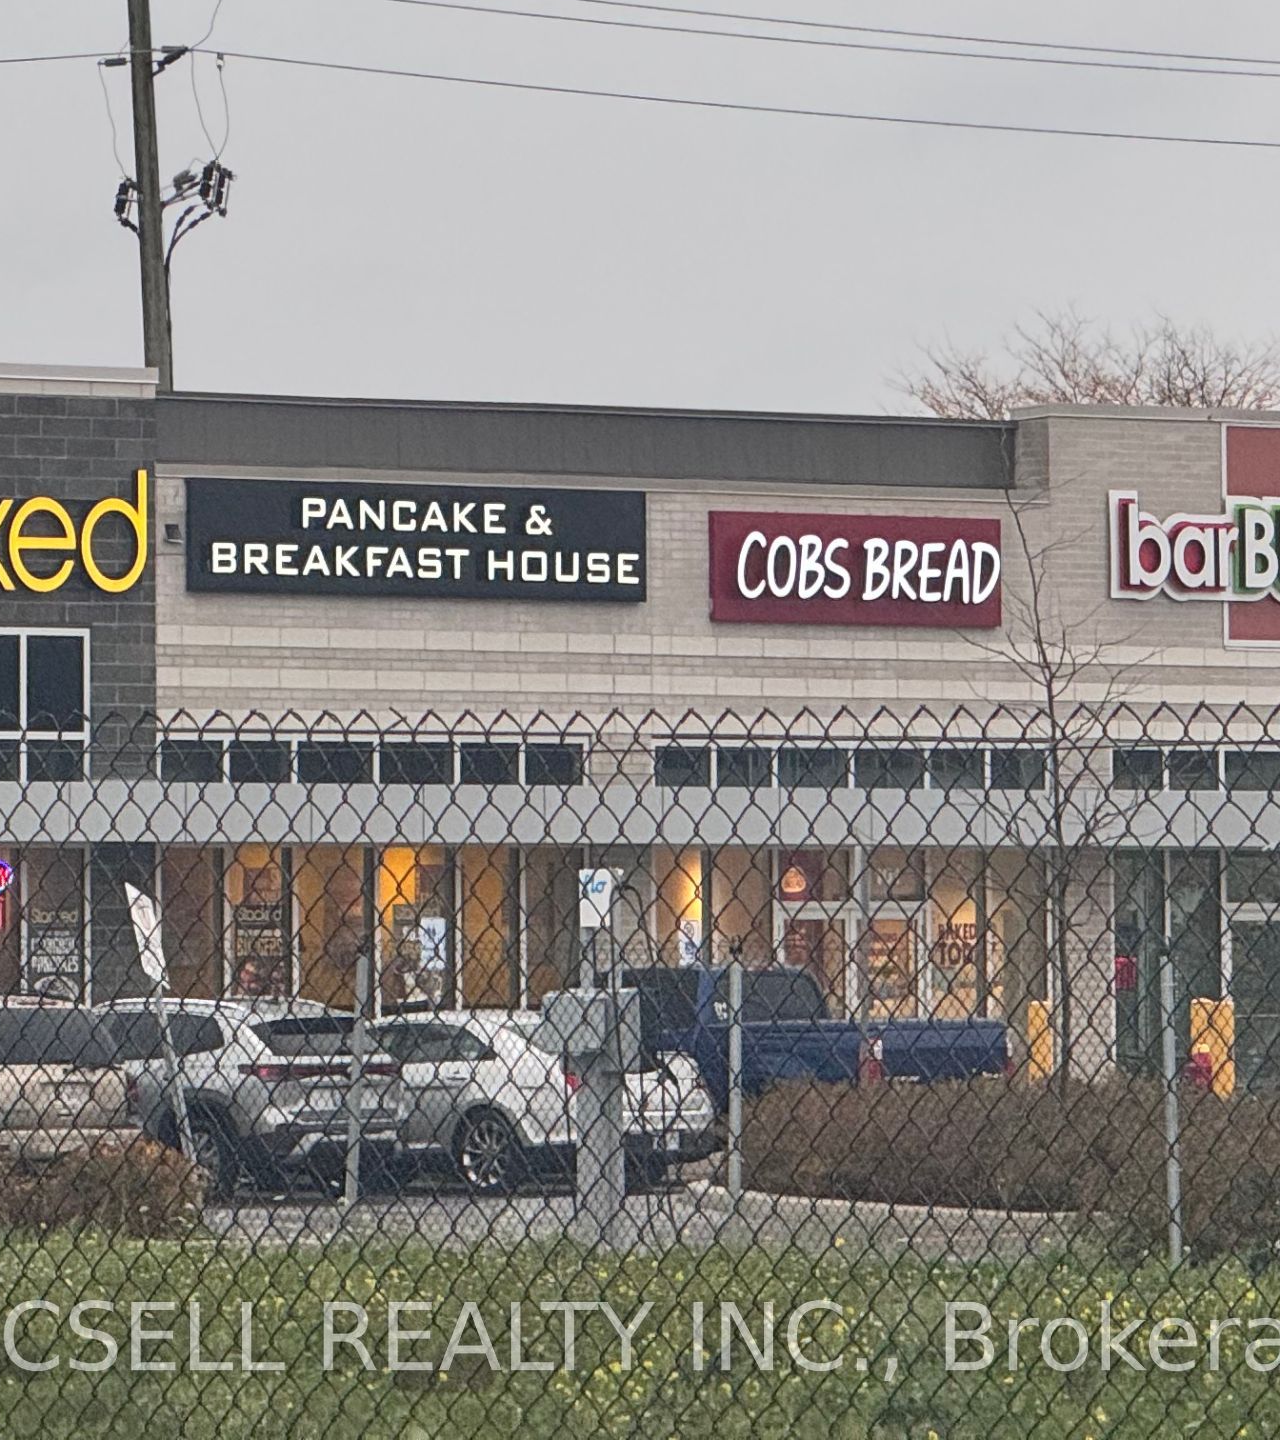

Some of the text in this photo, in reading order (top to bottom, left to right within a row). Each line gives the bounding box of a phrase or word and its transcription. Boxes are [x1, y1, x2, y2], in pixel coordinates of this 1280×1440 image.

[301, 497, 553, 536] PANCAKE &
[210, 542, 640, 585] BREAKFAST HOUSE
[737, 530, 1001, 604] COBS BREAD
